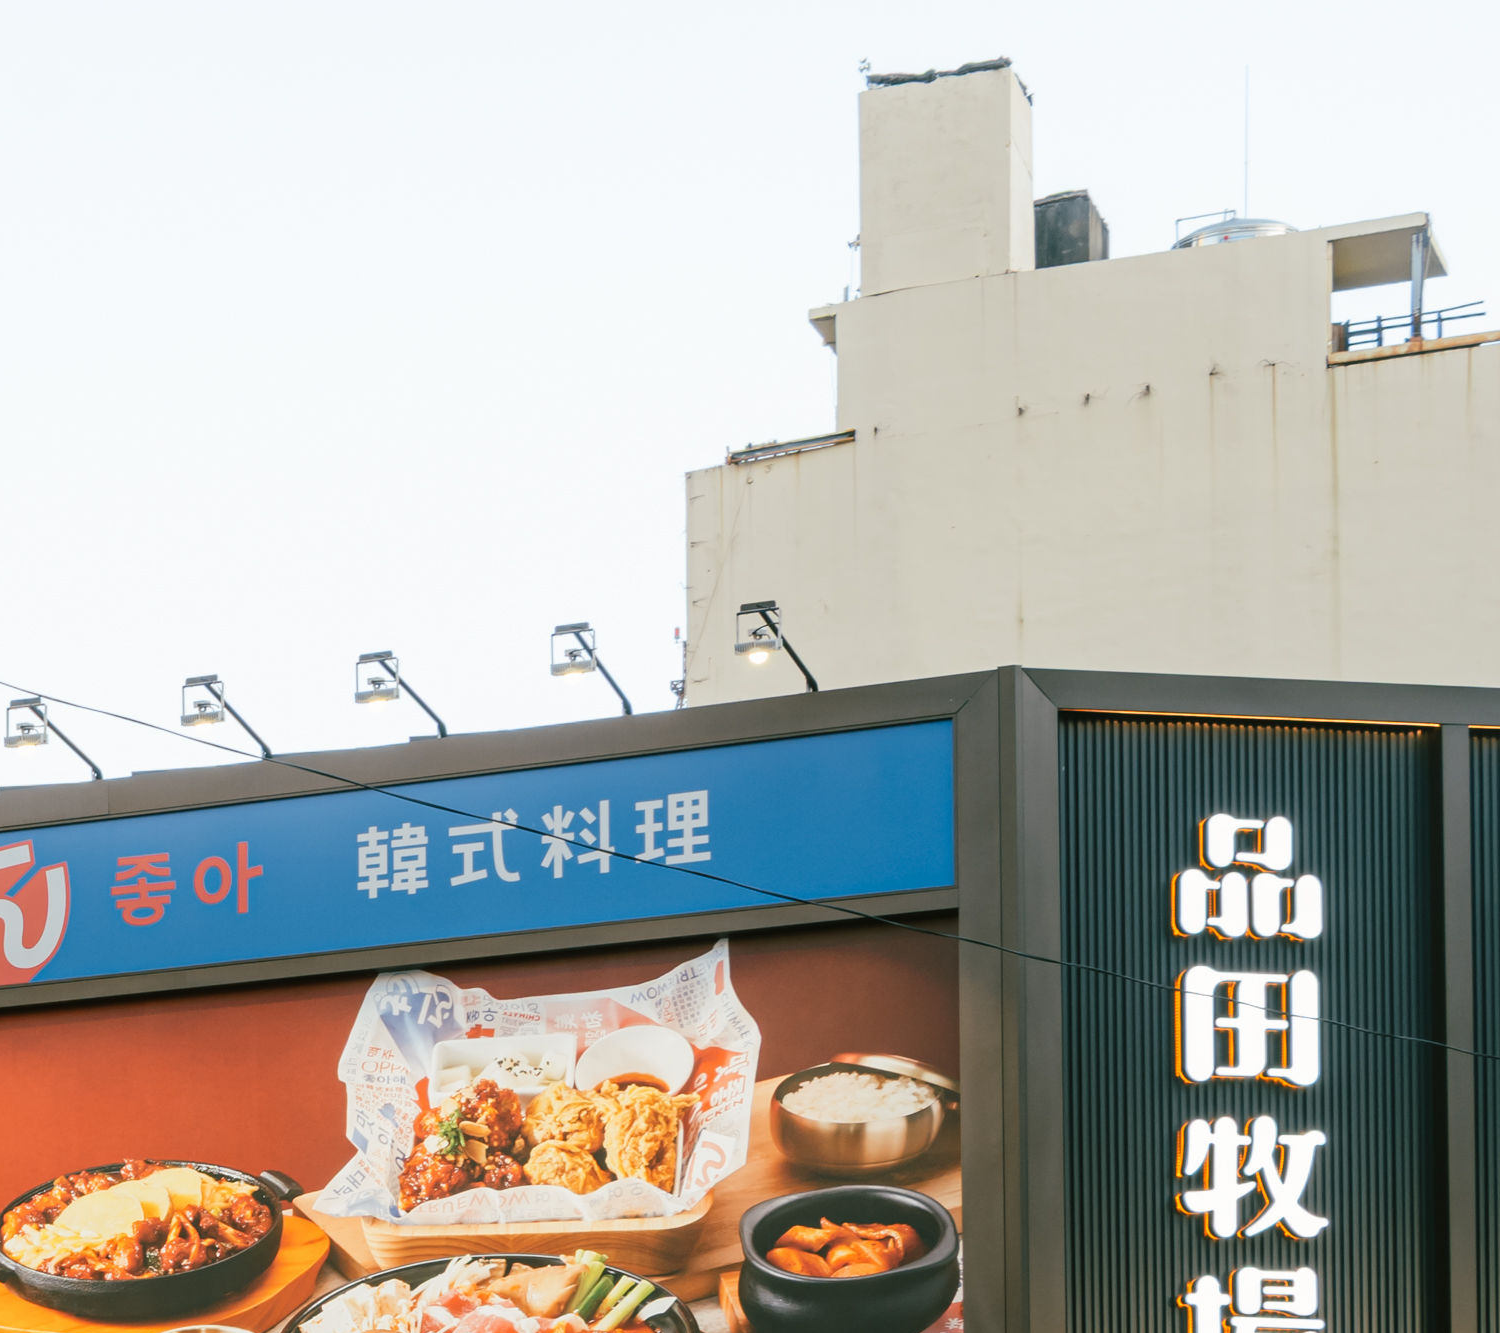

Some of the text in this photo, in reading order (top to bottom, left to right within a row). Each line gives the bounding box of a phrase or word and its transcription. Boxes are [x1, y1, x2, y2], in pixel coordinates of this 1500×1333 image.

[110, 840, 264, 926] 좋아
[355, 789, 713, 901] 韓式料理
